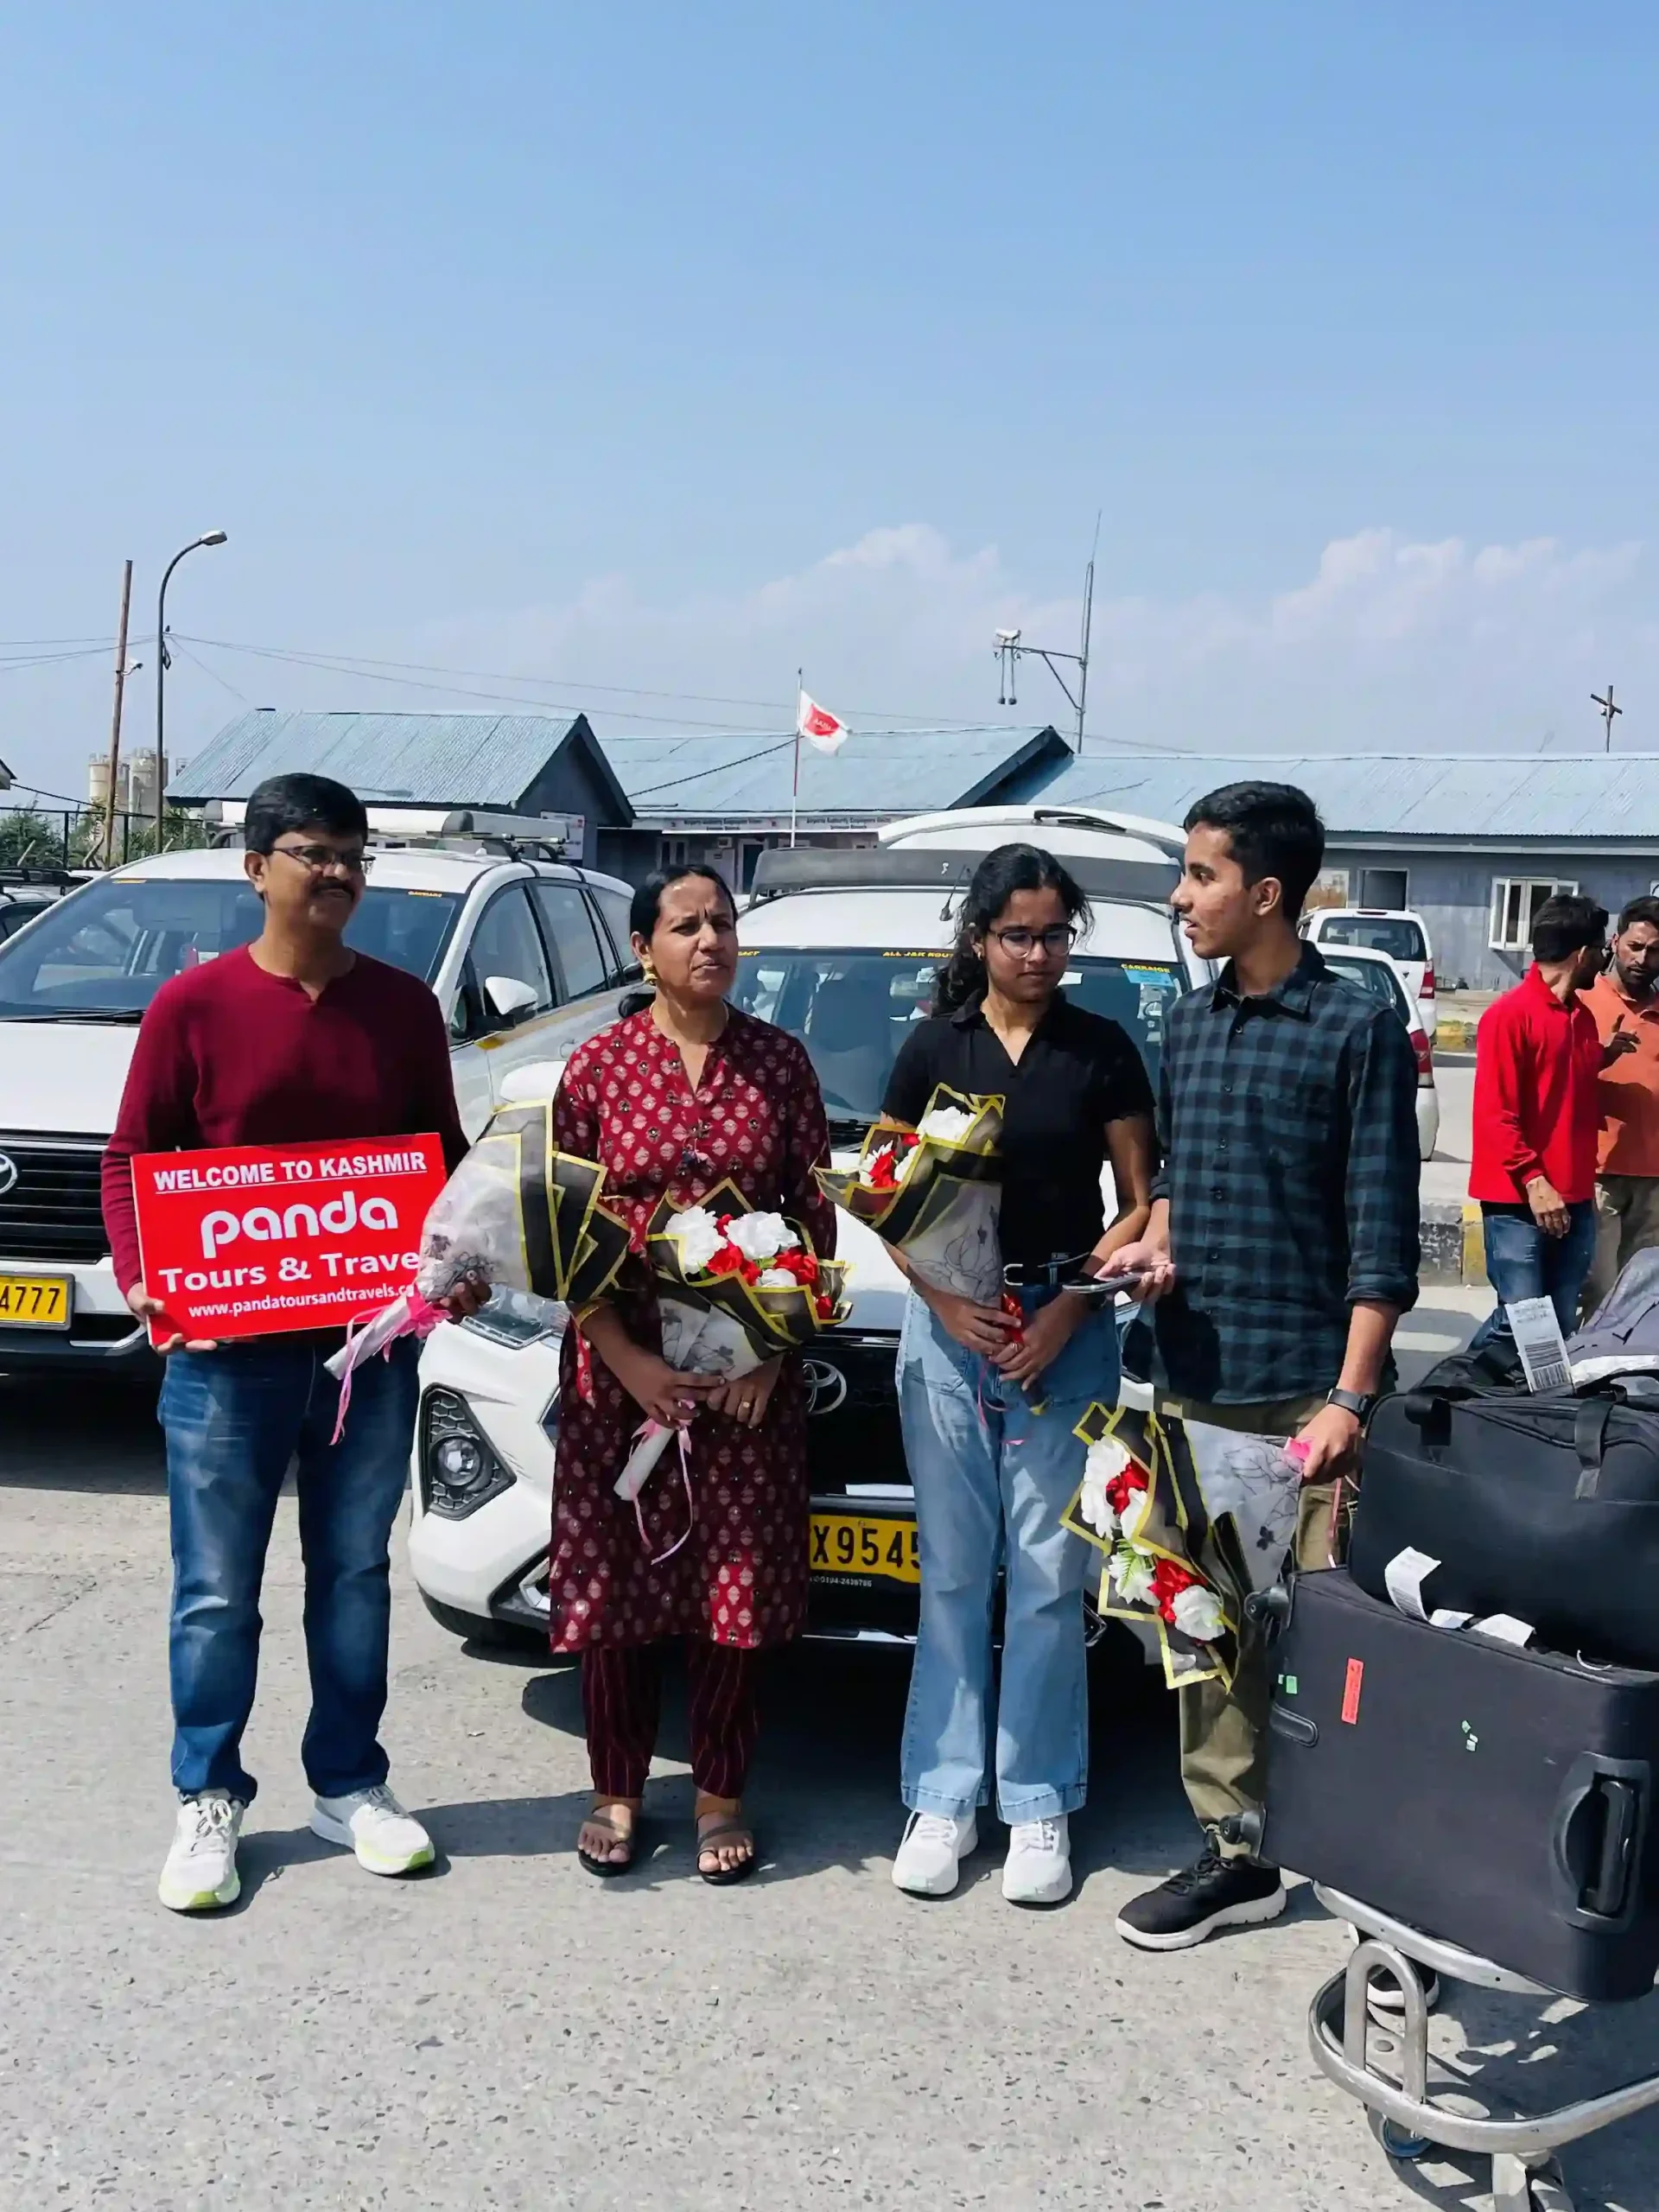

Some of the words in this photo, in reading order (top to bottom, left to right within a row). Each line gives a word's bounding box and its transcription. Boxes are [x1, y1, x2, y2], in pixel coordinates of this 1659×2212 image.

[153, 1163, 275, 1192] WELCOME
[280, 1160, 313, 1180] TO
[320, 1151, 427, 1177] KASHMIR
[200, 1191, 398, 1259] panda
[158, 1265, 266, 1294] Tours
[278, 1257, 312, 1281] &
